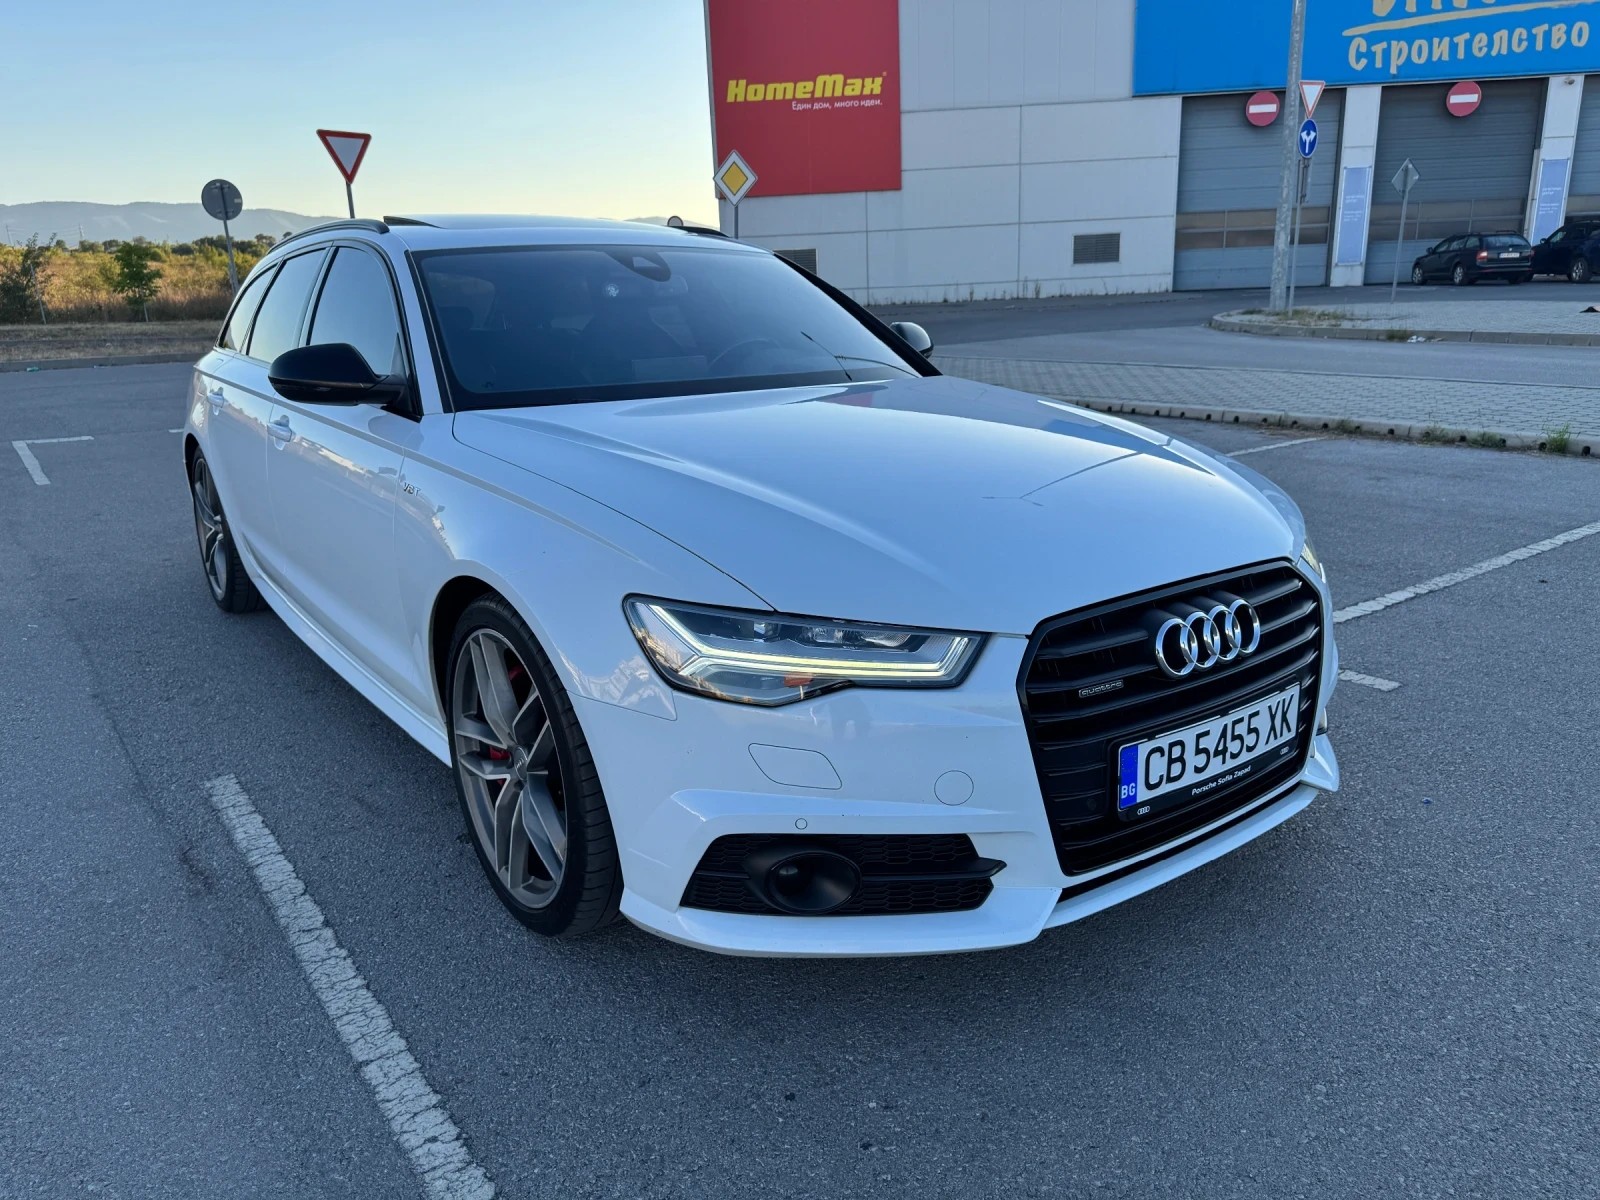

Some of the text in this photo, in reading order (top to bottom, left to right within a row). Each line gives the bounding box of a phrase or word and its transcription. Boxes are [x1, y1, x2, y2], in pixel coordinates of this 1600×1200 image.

[1348, 21, 1590, 75] Строителство
[726, 74, 883, 103] HomeMax
[792, 98, 883, 111] Един дом, много идеи.
[1081, 681, 1122, 696] quattro
[1144, 693, 1295, 791] CB 5455 XK
[1121, 782, 1136, 799] BG
[1191, 764, 1251, 796] Porsche Sofia Zapad
